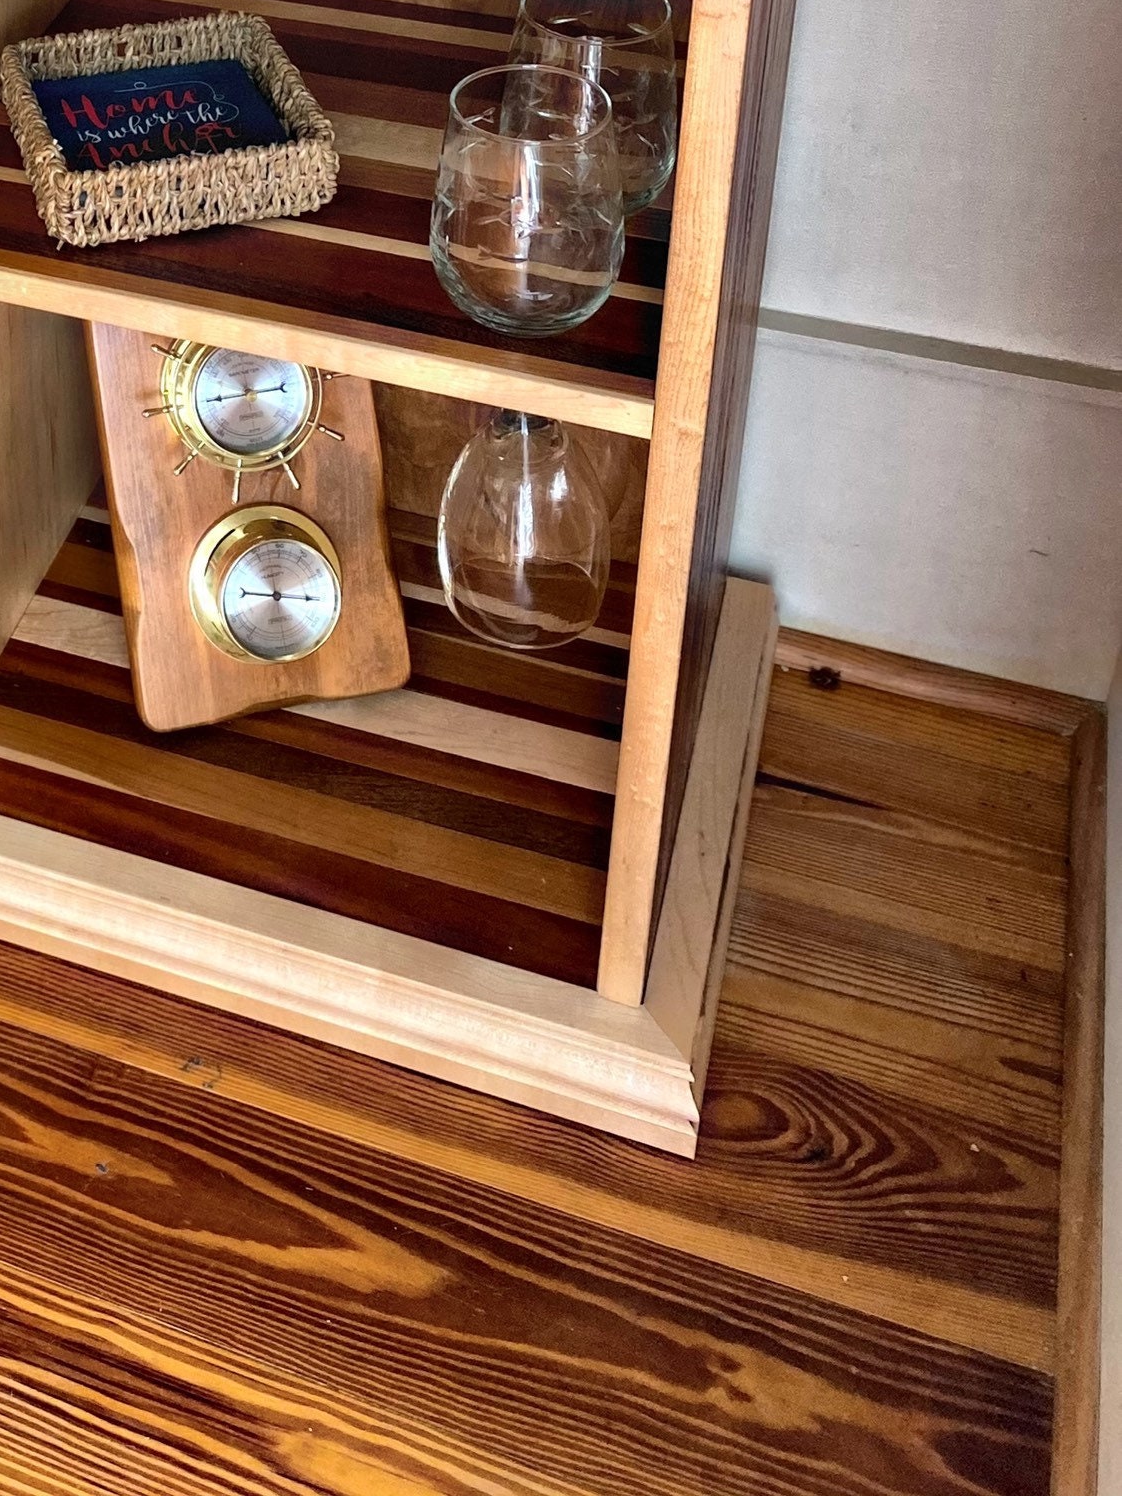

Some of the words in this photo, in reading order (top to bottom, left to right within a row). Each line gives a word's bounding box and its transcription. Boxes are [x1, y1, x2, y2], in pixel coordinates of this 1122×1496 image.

[61, 89, 201, 130] Home
[77, 129, 103, 144] is
[107, 109, 179, 140] where
[181, 102, 228, 125] the
